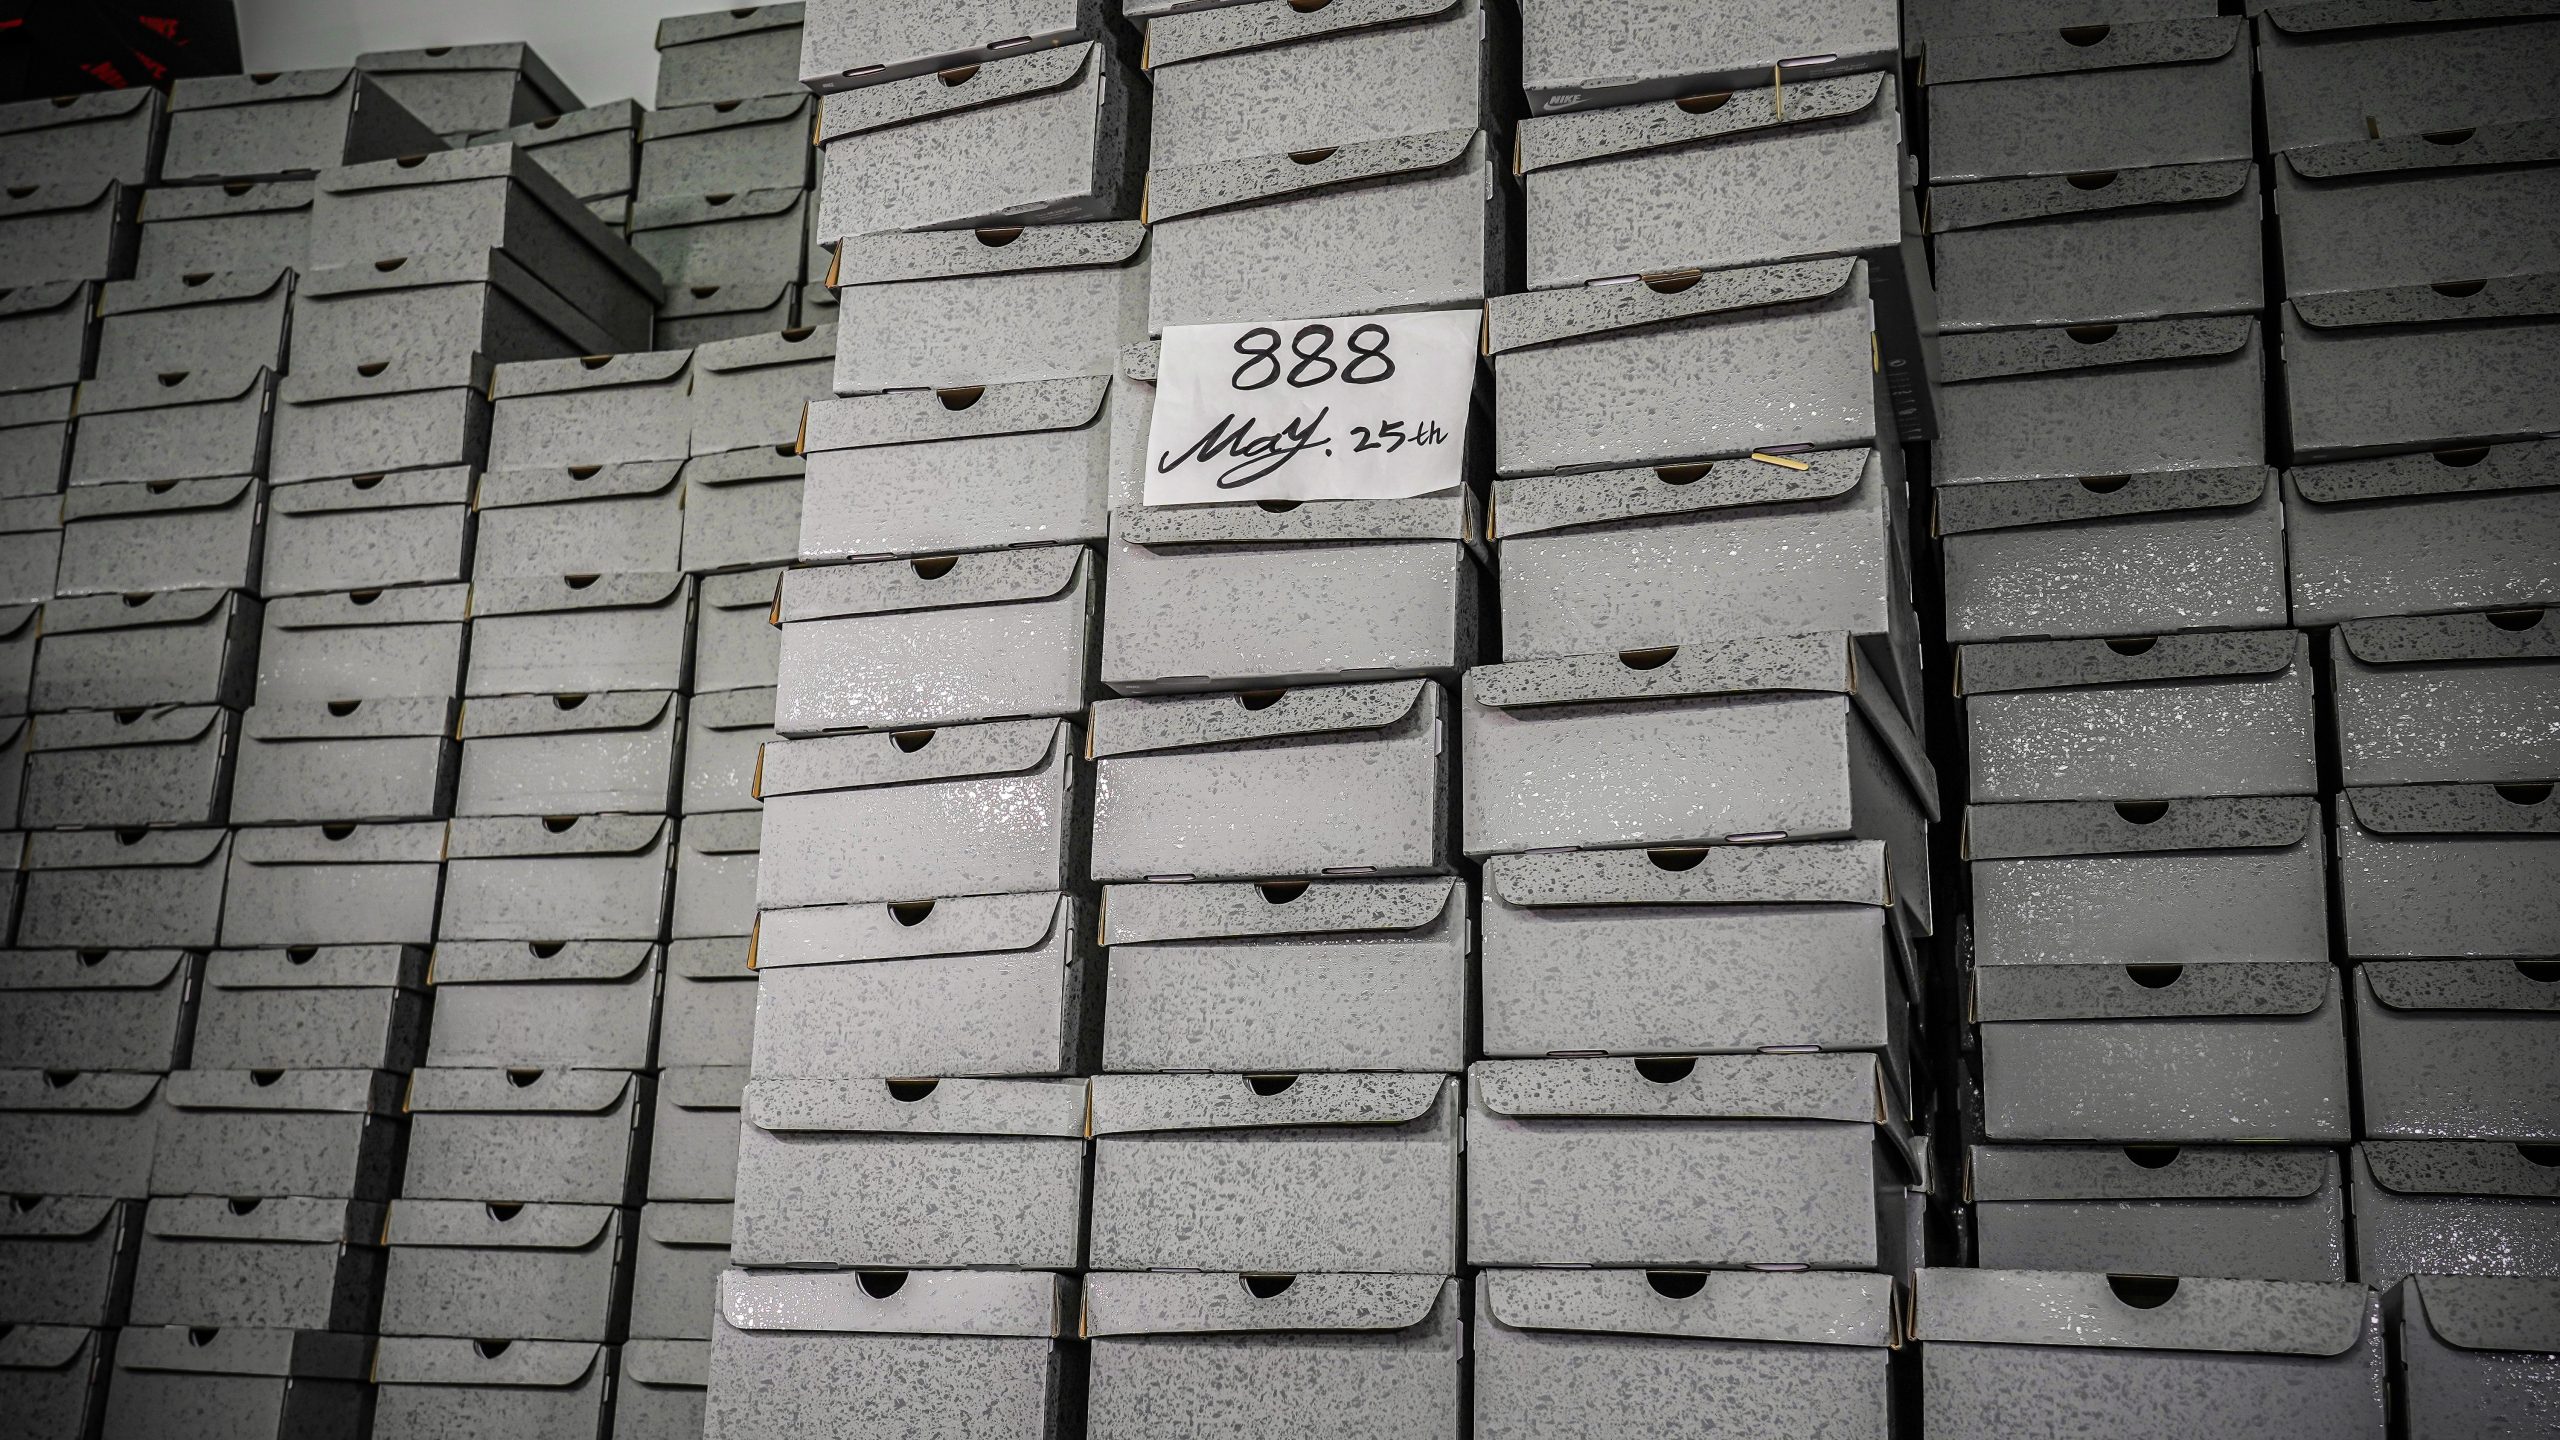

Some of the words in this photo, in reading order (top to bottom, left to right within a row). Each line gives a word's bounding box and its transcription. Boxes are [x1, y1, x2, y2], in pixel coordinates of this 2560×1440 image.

[1549, 94, 1582, 105] NIKE
[1231, 323, 1396, 391] 888
[1349, 420, 1449, 453] 25th
